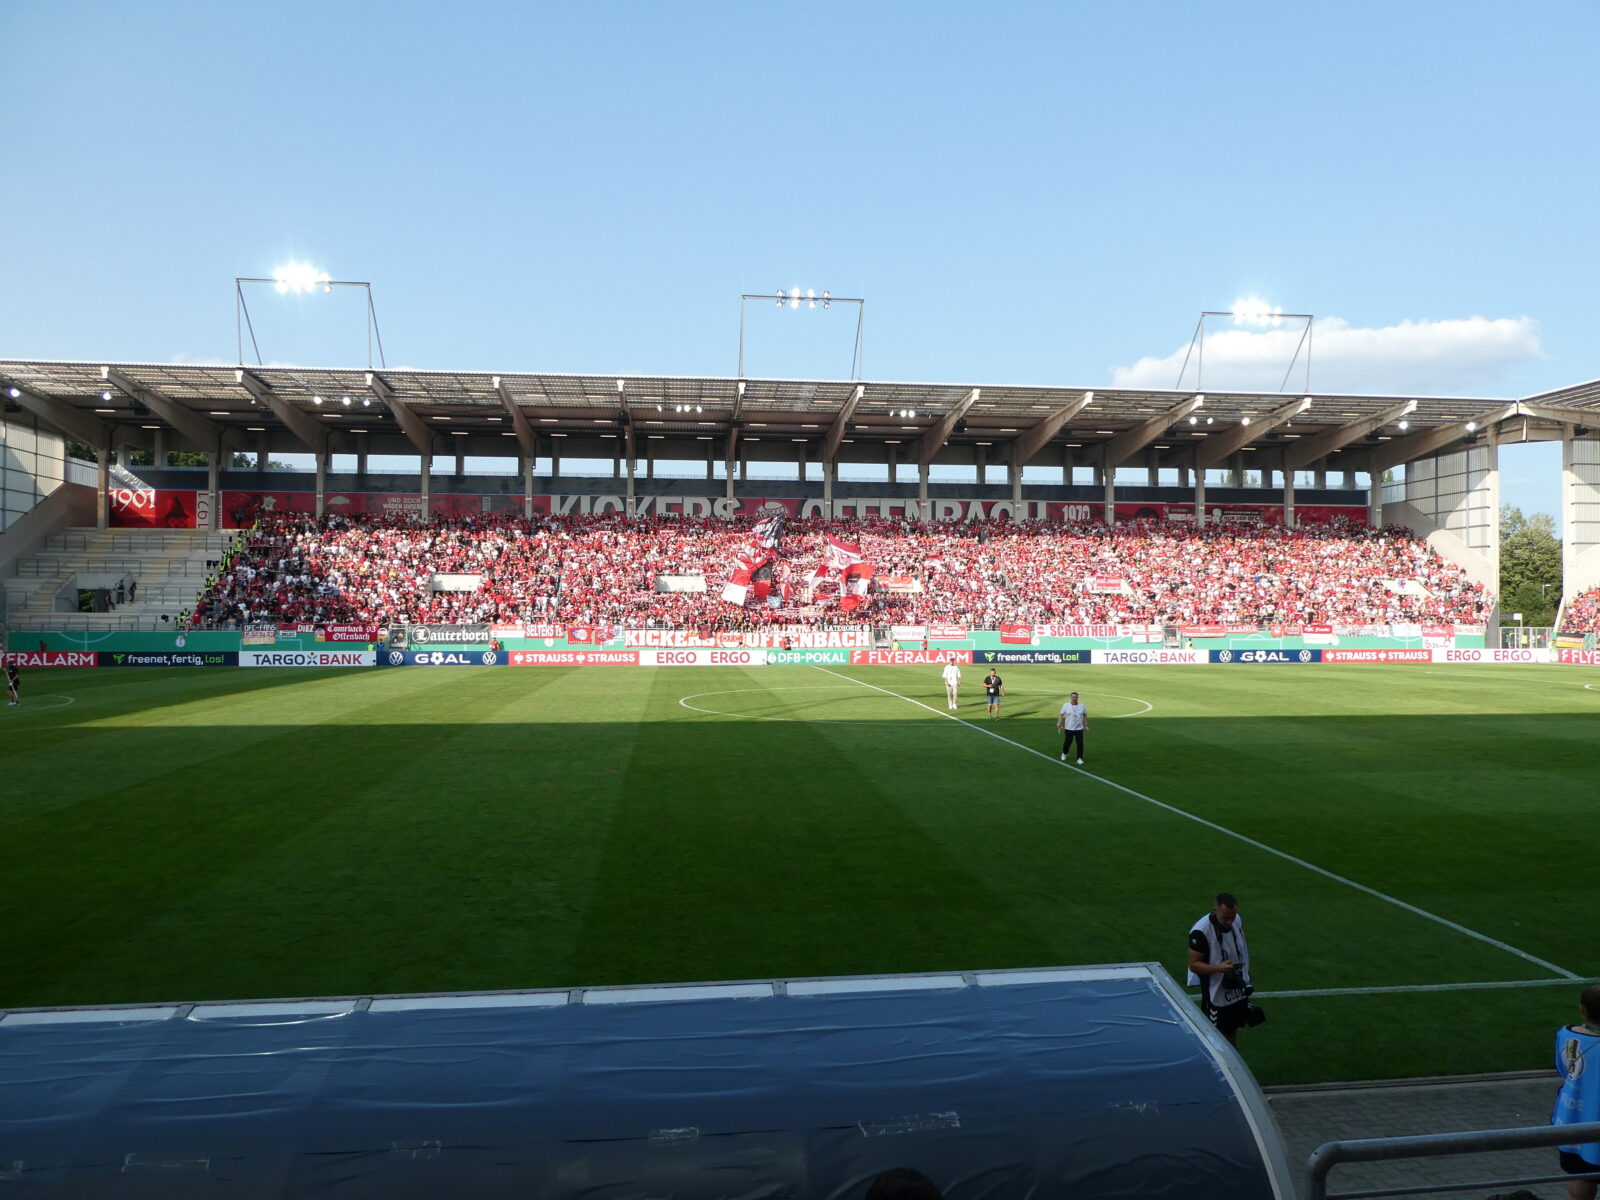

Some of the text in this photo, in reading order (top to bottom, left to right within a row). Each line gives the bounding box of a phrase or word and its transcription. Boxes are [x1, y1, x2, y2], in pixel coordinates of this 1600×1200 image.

[108, 488, 156, 512] 1901
[551, 496, 740, 518] KICKERS
[366, 625, 376, 633] 93
[414, 627, 489, 642] Lauterborn
[526, 653, 635, 663] STRAUSS STRAUSS
[656, 652, 751, 664] ERGO ERGO
[777, 652, 846, 663] DFB-POKAL
[868, 651, 969, 664] FLYERALARM
[1335, 651, 1429, 660] STRAUSS STRAUSS
[1446, 650, 1532, 661] ERGO ERGO
